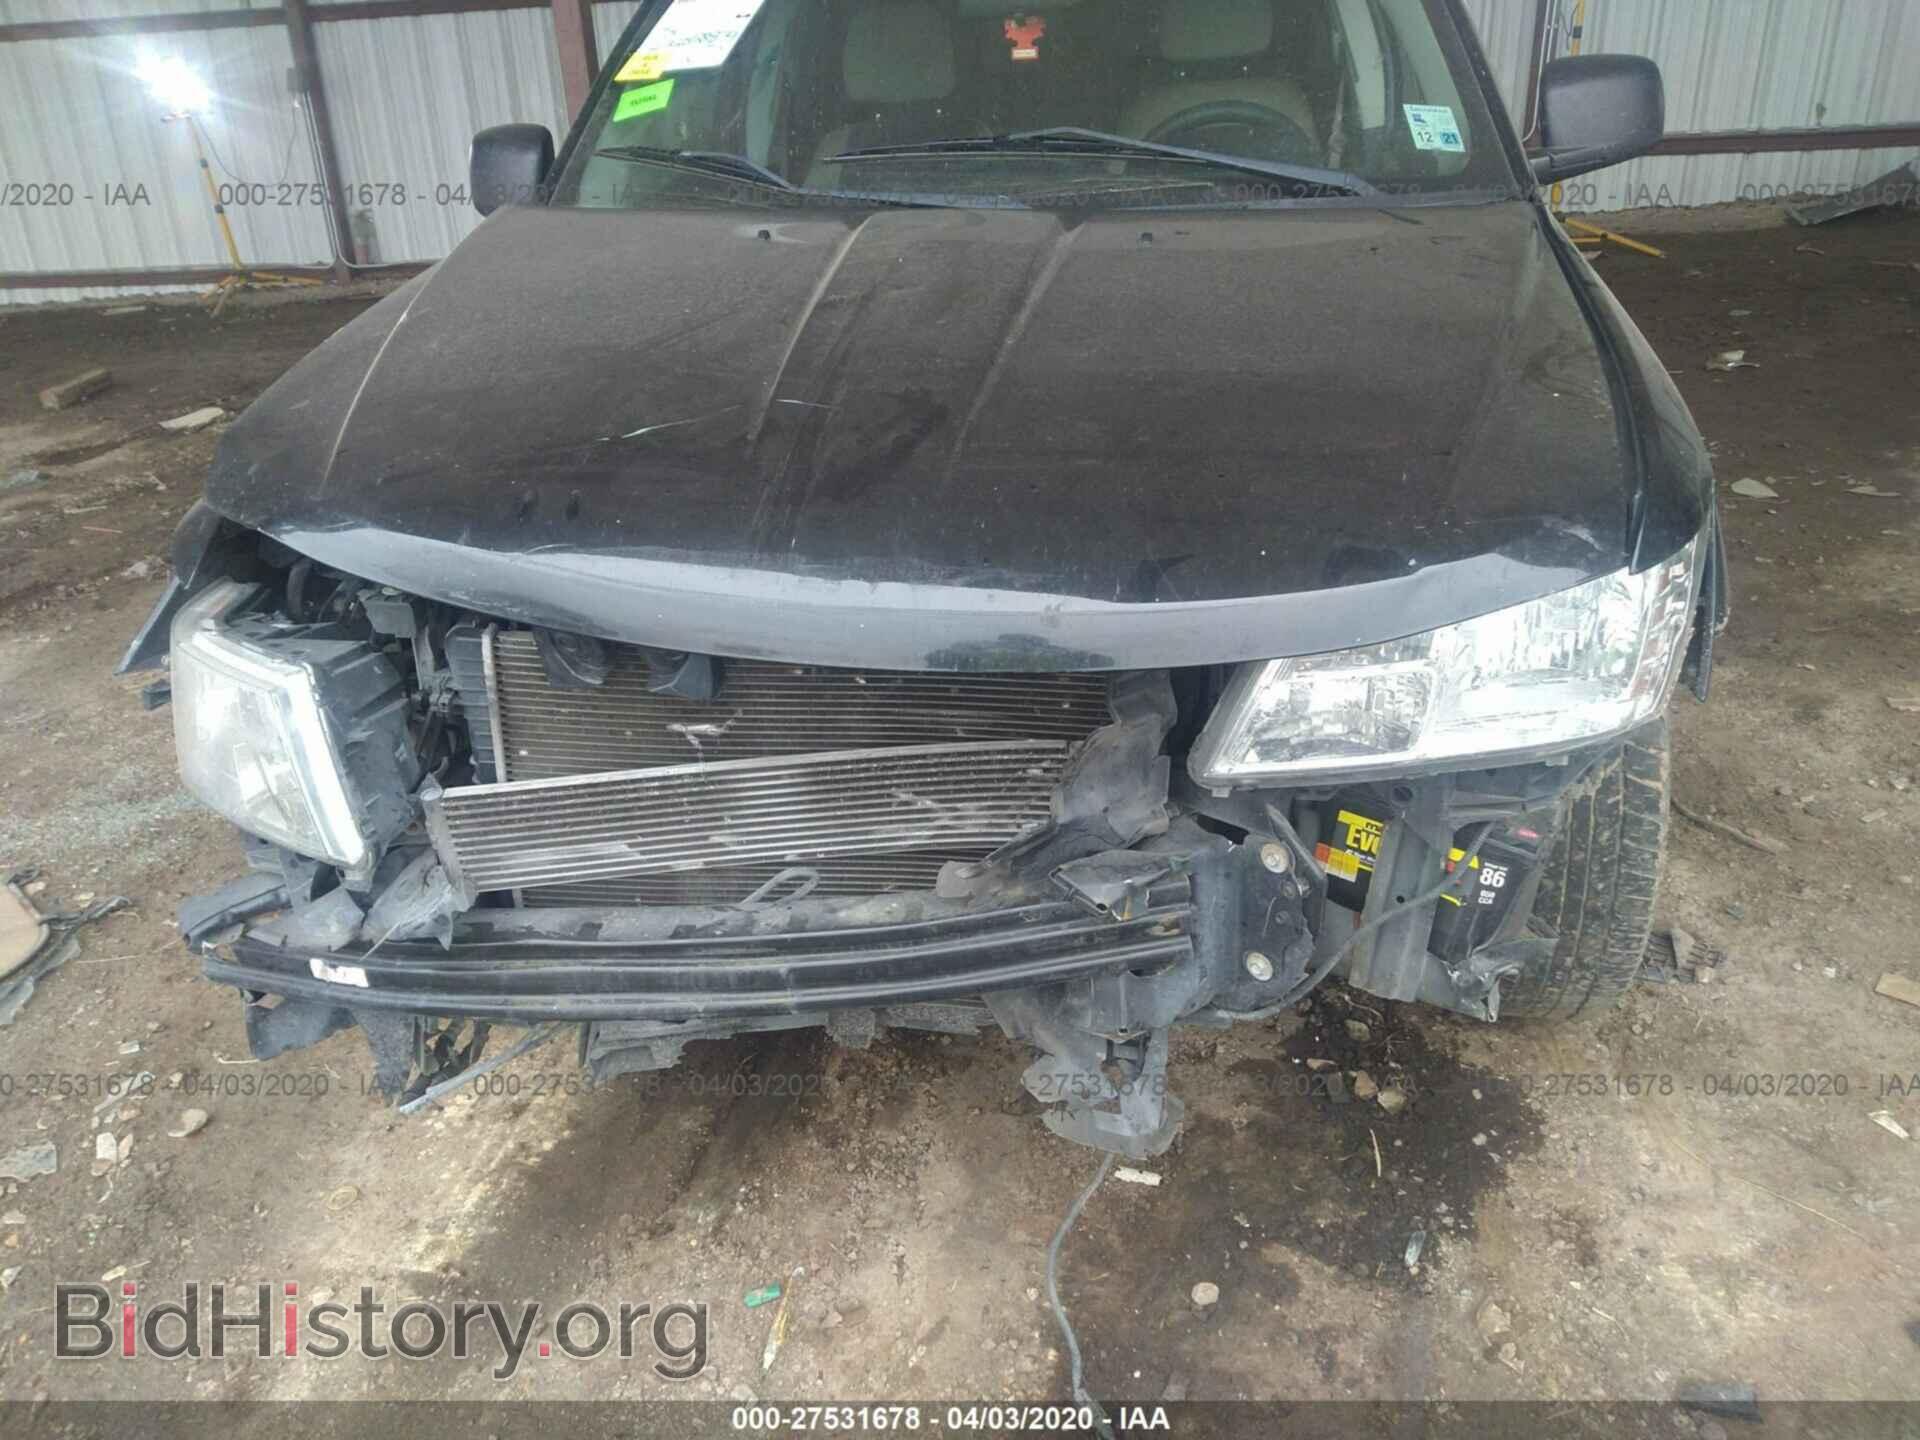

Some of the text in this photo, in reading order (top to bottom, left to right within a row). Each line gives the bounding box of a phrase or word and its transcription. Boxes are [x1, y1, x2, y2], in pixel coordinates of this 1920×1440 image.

[1417, 131, 1459, 145] 12 21
[1479, 867, 1507, 888] 86
